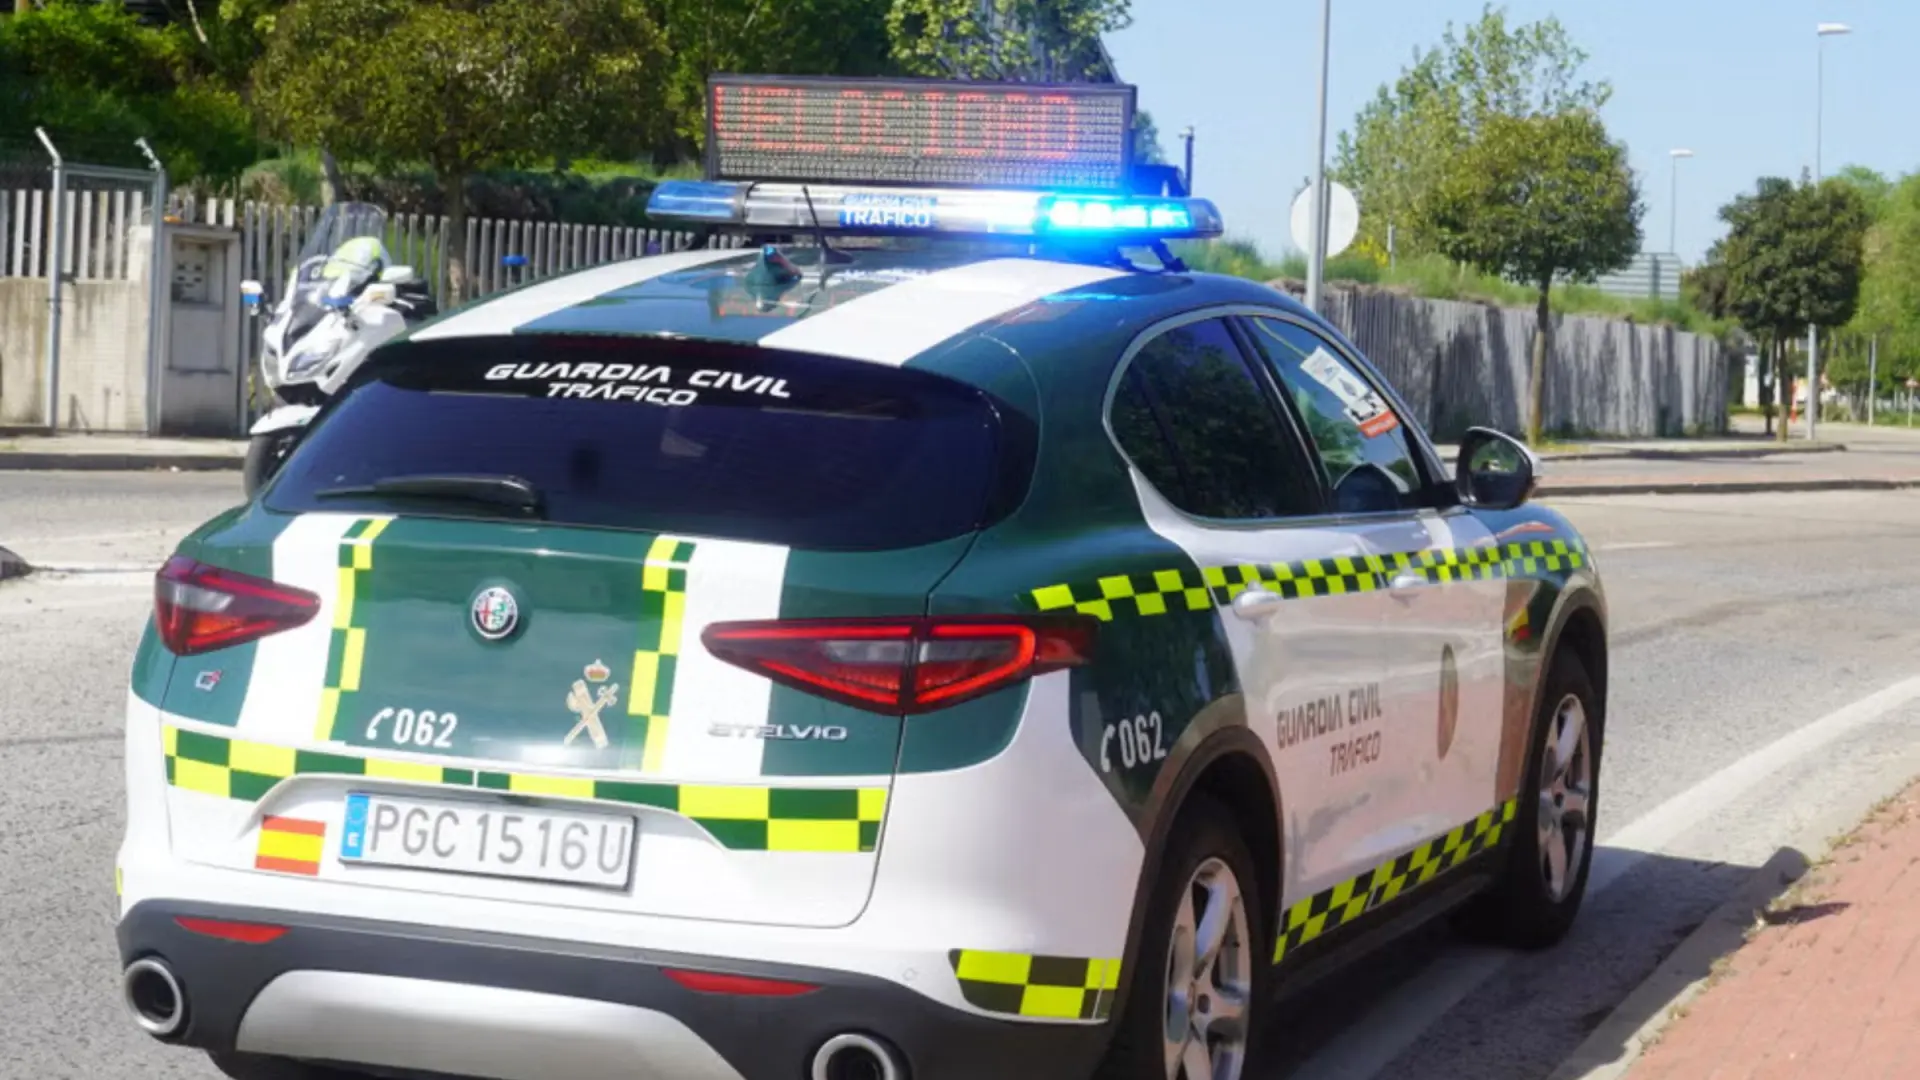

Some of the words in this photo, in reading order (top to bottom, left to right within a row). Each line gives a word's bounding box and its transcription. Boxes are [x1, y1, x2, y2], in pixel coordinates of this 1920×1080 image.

[484, 362, 672, 383] GUARDIA
[688, 369, 790, 398] CIVIL
[392, 707, 459, 748] 062
[707, 723, 848, 742] STELVIO
[1276, 693, 1343, 751] GUARDIA
[1348, 682, 1382, 726] CIVIL
[1119, 711, 1166, 769] 062
